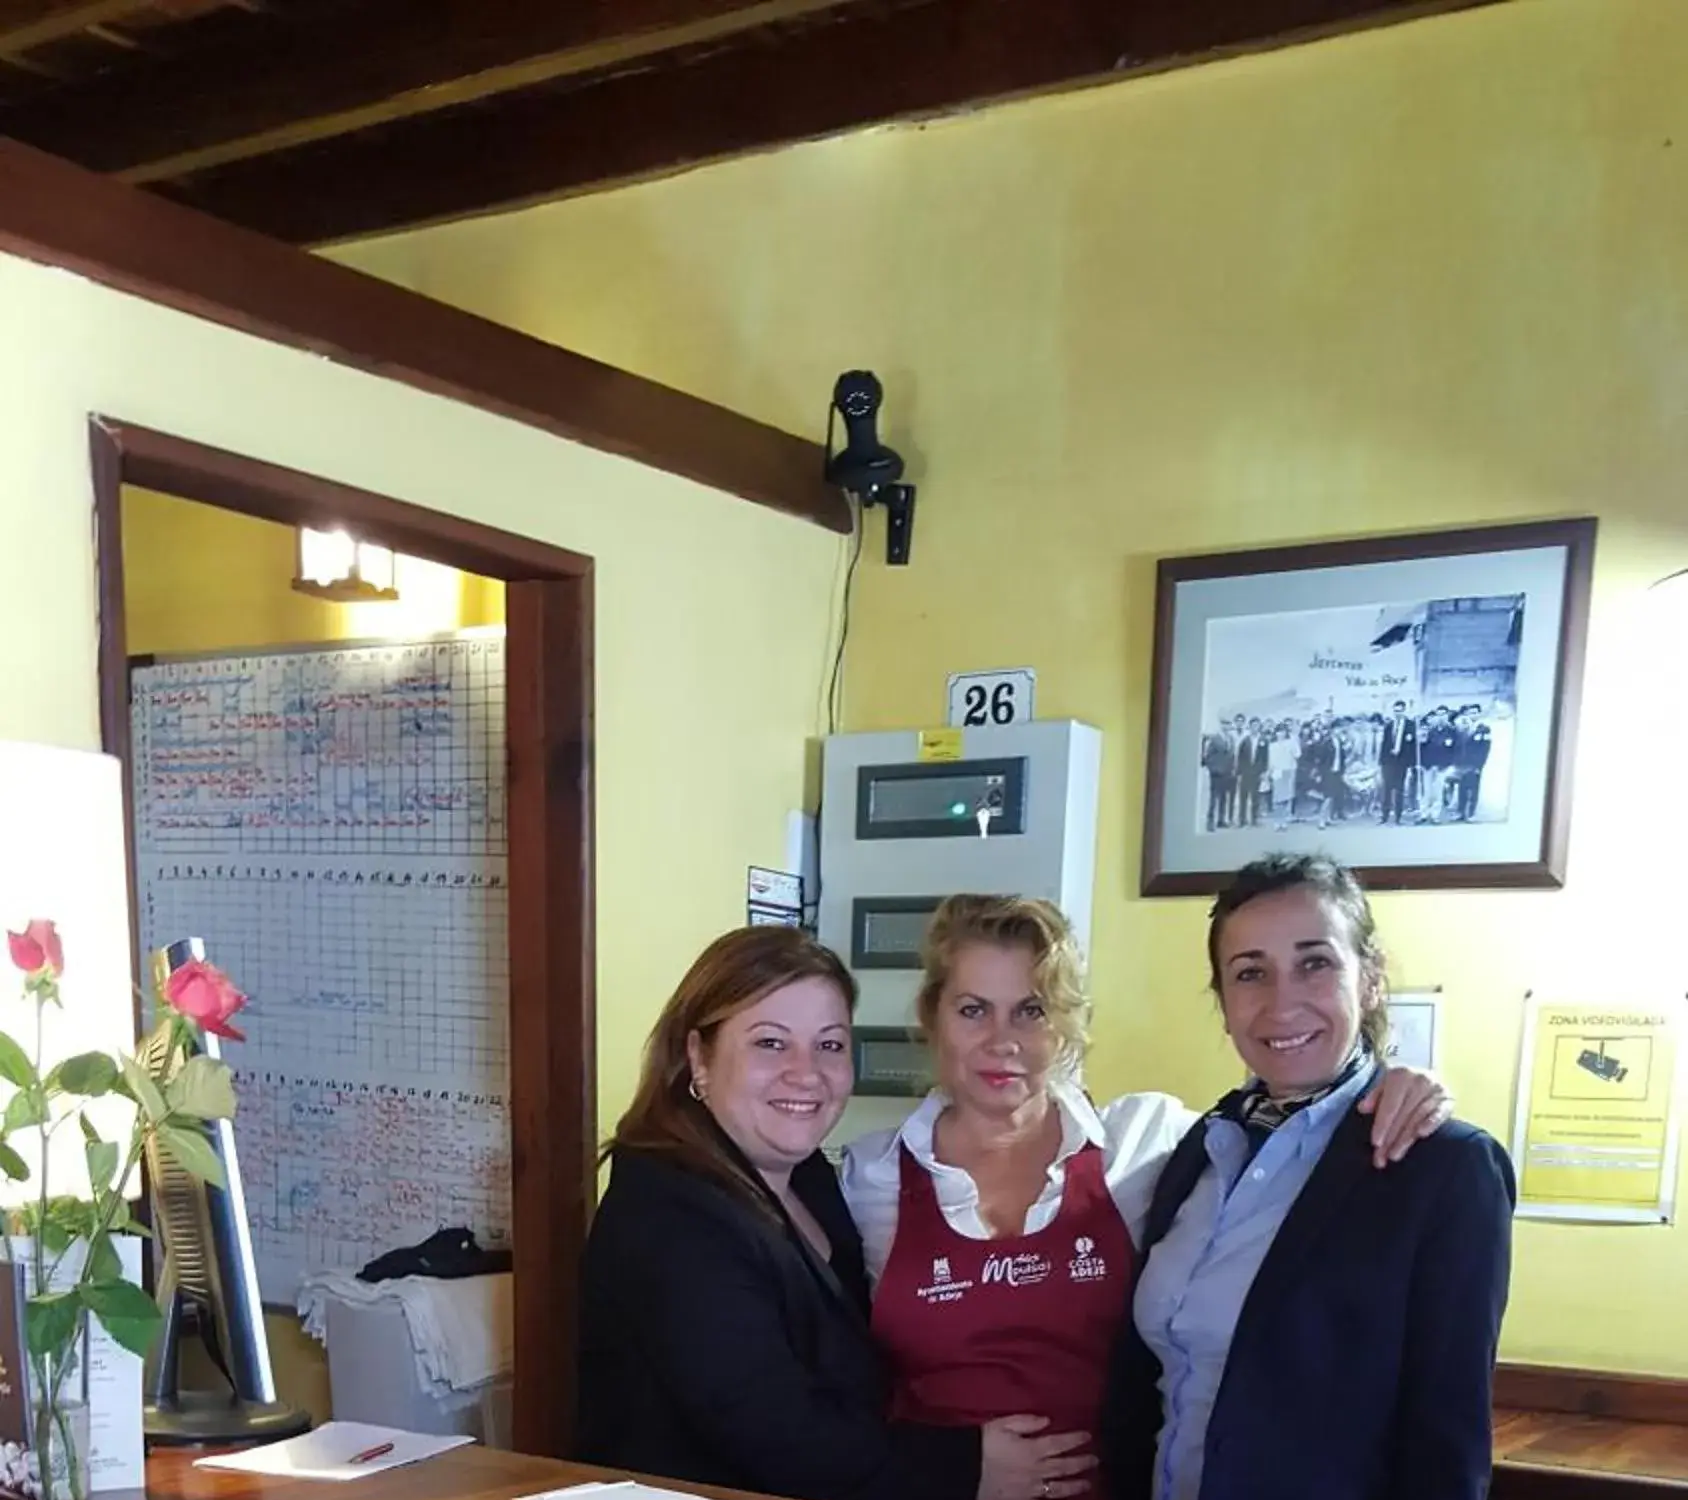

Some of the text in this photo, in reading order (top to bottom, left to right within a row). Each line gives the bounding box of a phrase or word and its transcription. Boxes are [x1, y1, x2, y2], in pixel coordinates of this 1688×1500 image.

[963, 682, 1015, 727] 26
[1549, 1015, 1579, 1026] ZONA
[1069, 1257, 1105, 1269] COSTA
